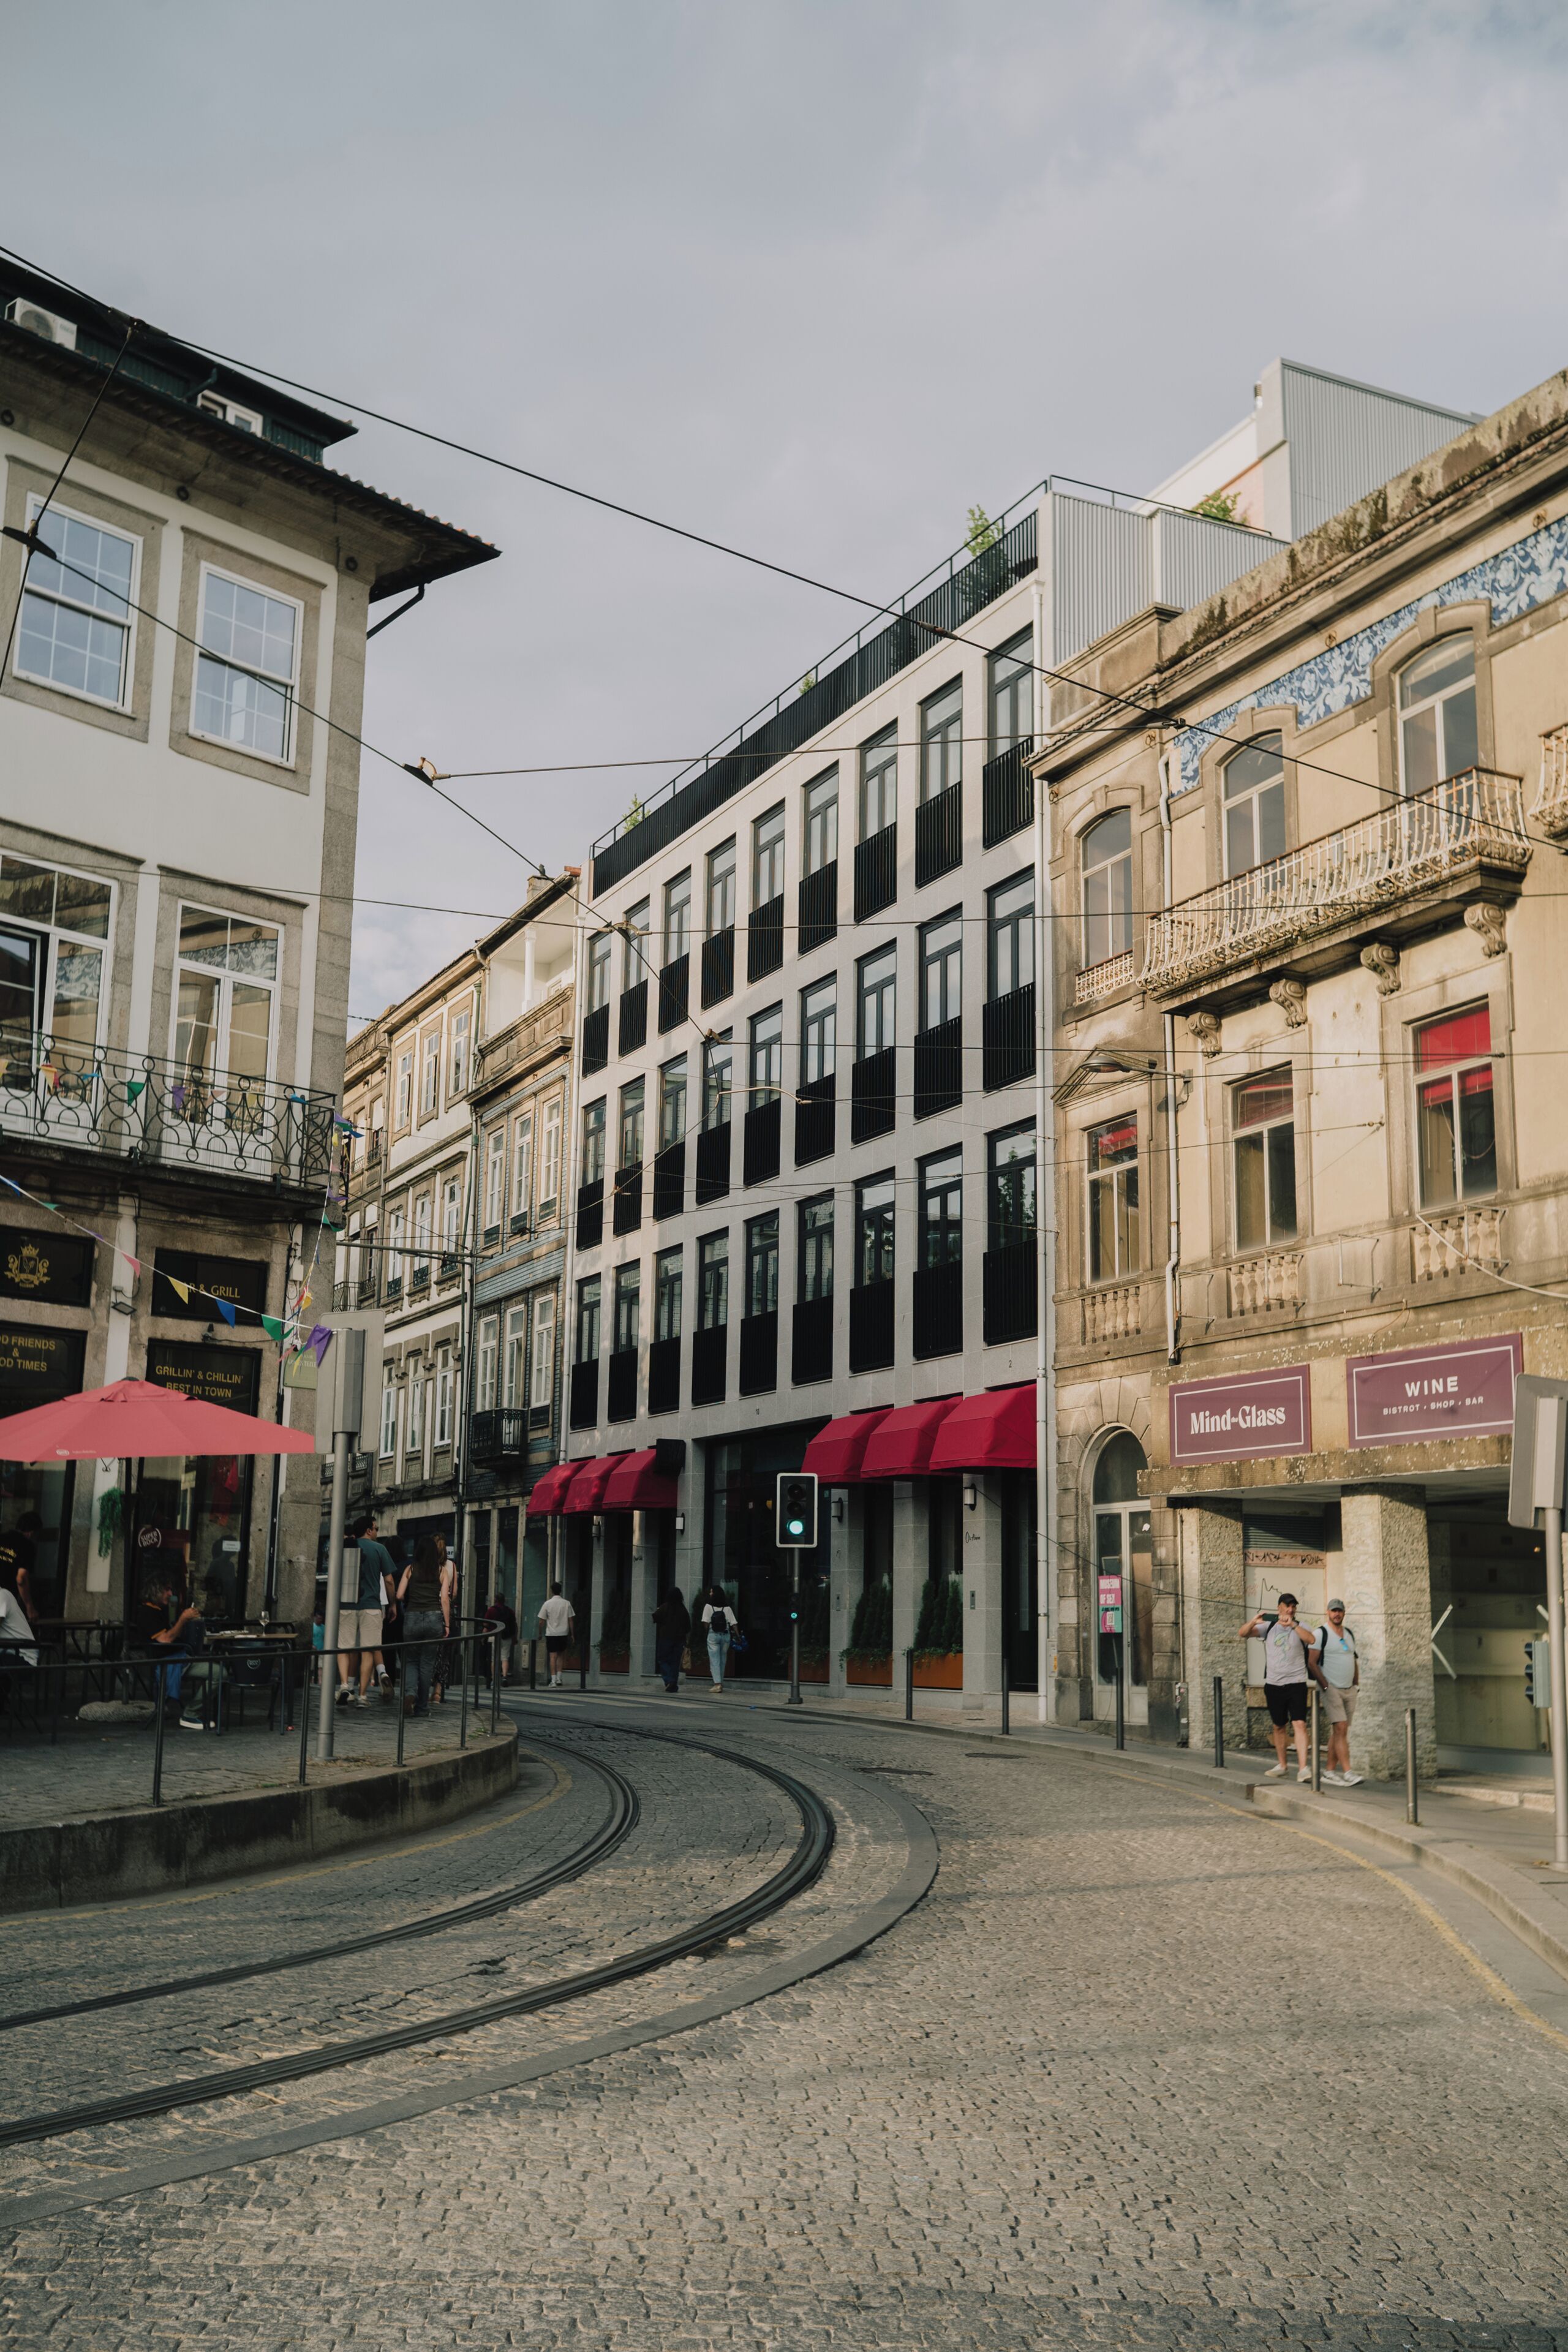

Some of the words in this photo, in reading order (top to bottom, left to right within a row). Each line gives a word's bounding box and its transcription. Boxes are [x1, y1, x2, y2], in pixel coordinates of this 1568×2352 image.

[211, 1285, 241, 1298] GRILL
[12, 1336, 56, 1351] FRIENDS
[12, 1348, 19, 1357] &
[17, 1359, 47, 1372] TIMES
[1009, 1359, 1012, 1368] 2
[156, 1365, 195, 1378] GRILLIN'
[197, 1371, 203, 1380] &
[206, 1371, 244, 1384] CHILLIN'
[193, 1385, 202, 1395] IN
[205, 1387, 232, 1398] TOWN
[1404, 1376, 1458, 1398] WINE
[1382, 1404, 1420, 1415] BISTROT
[1430, 1400, 1455, 1410] SHOP
[1465, 1396, 1484, 1406] BAR
[1190, 1408, 1231, 1434] Mind
[1238, 1404, 1286, 1429] Glass
[140, 1531, 157, 1541] SUPER
